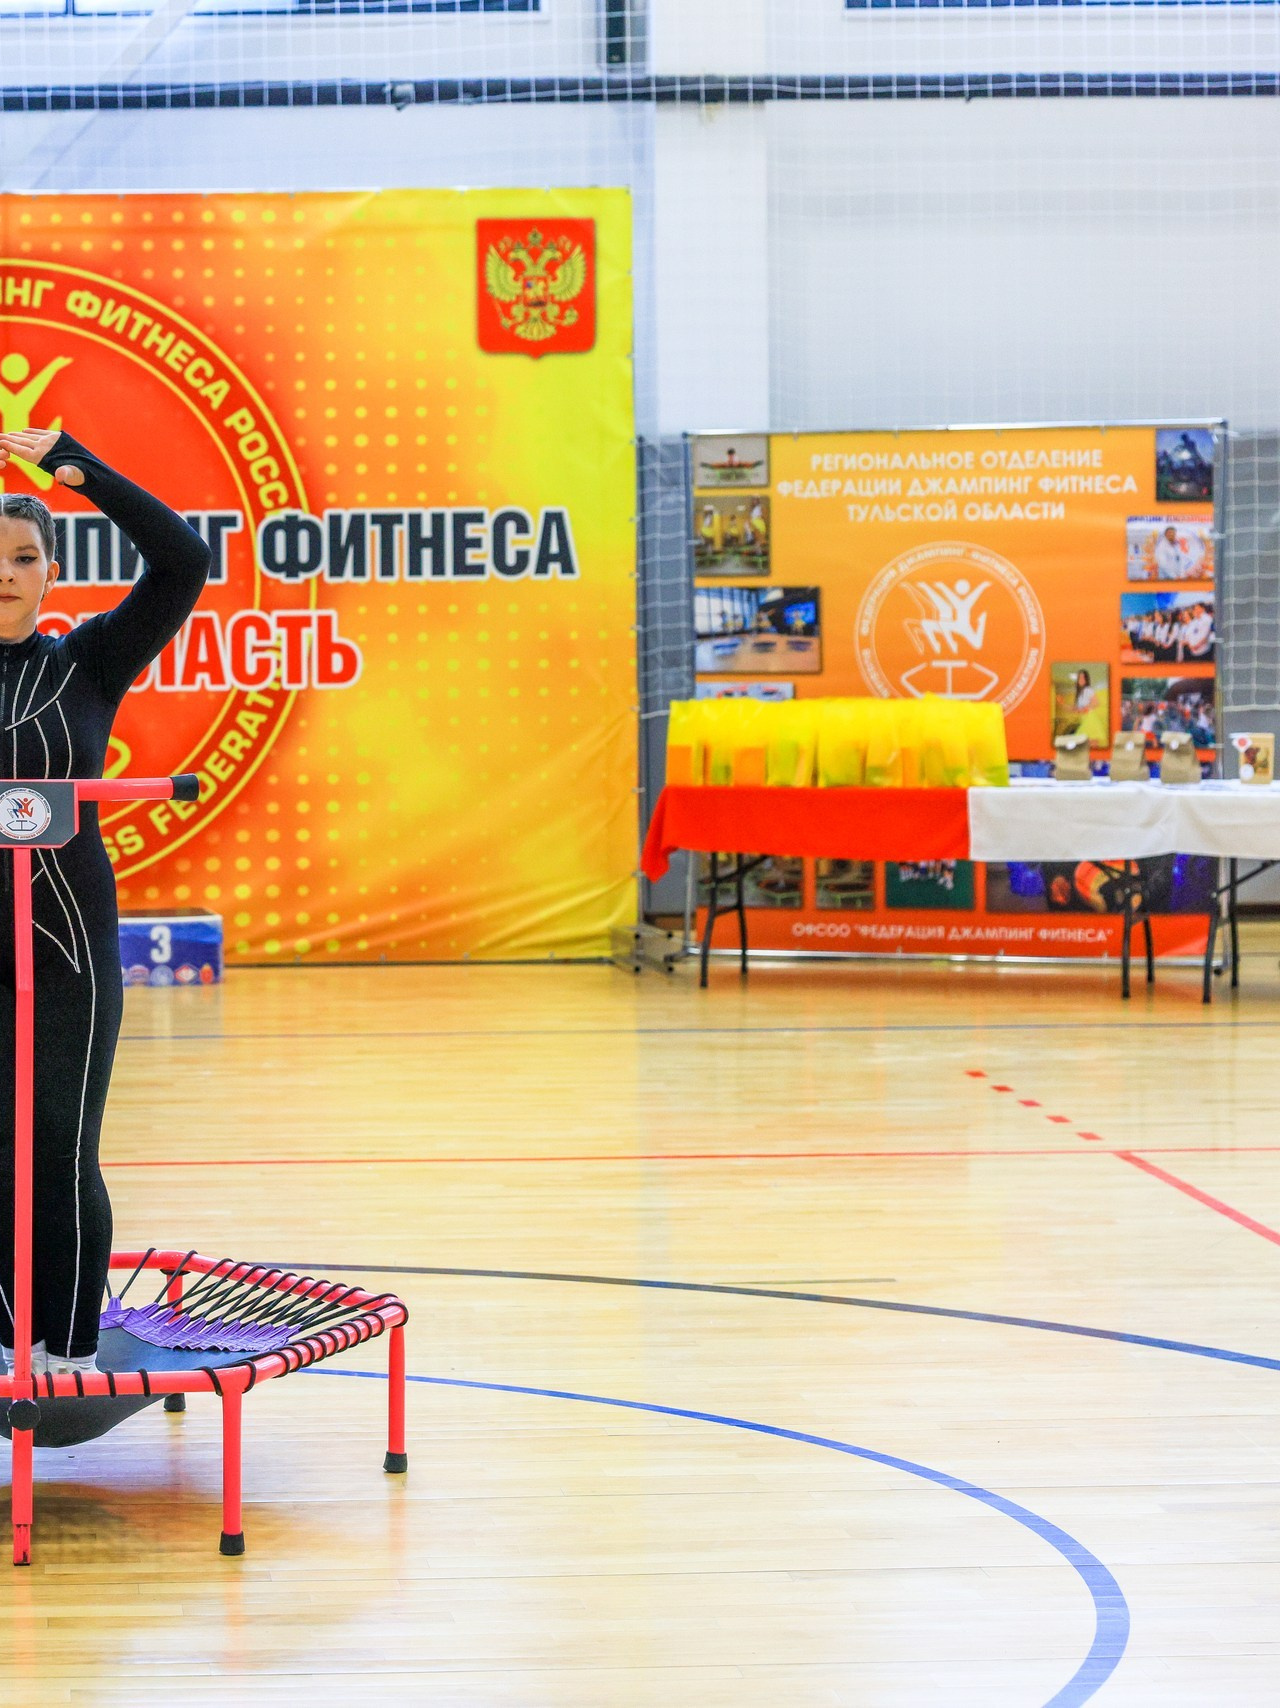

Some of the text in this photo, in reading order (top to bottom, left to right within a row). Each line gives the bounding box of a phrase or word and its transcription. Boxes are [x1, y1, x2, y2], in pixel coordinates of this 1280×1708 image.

[65, 290, 232, 411] ФИТНЕСА
[222, 407, 295, 516] РОСС
[811, 448, 1104, 473] РЕГИОНАЛЬНОЕ ОТДЕЛЕНИЕ
[776, 473, 1139, 500] ФЕДЕРАЦИИ ДЖАМПИНГ ФИТНЕСА
[847, 498, 1066, 524] ТУЛЬСКОЙ ОБЛАСТИ
[255, 506, 580, 582] ФИТНЕСА
[150, 924, 172, 964] 3
